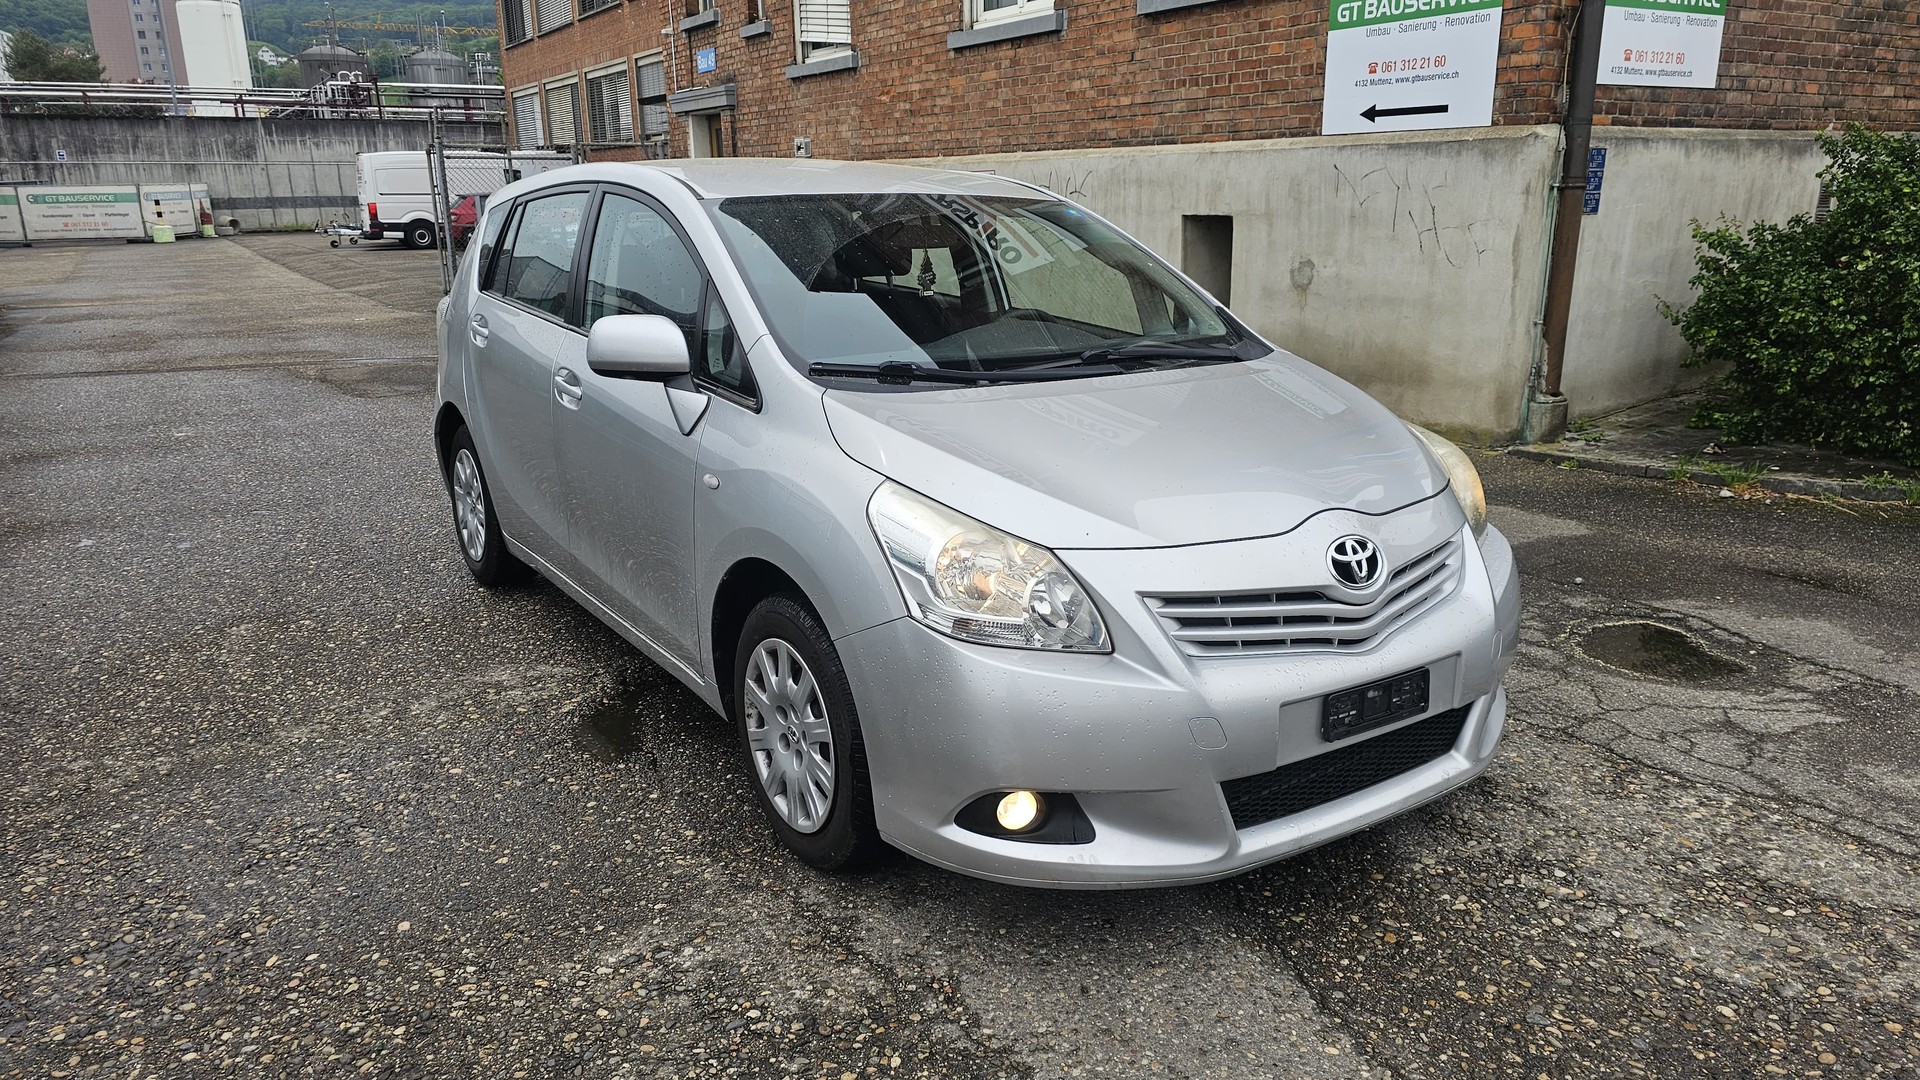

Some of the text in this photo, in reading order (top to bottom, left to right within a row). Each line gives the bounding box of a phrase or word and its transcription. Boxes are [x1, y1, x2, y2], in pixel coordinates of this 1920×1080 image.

[1337, 0, 1493, 23] GT BAUSER
[1624, 10, 1718, 28] Umbau Sanierung Renovation
[1366, 12, 1491, 38] Umbau Sanierung Renovation
[1381, 55, 1447, 73] 061 312 21 60
[1635, 50, 1685, 65] 061 312 21 60
[1354, 71, 1460, 87] 4132 Muttenz, www.gtbauservice.ch
[1611, 66, 1692, 78] 4132 Muttenz, www.gtbauservice.ch
[45, 194, 115, 203] GT BAUSERVICE
